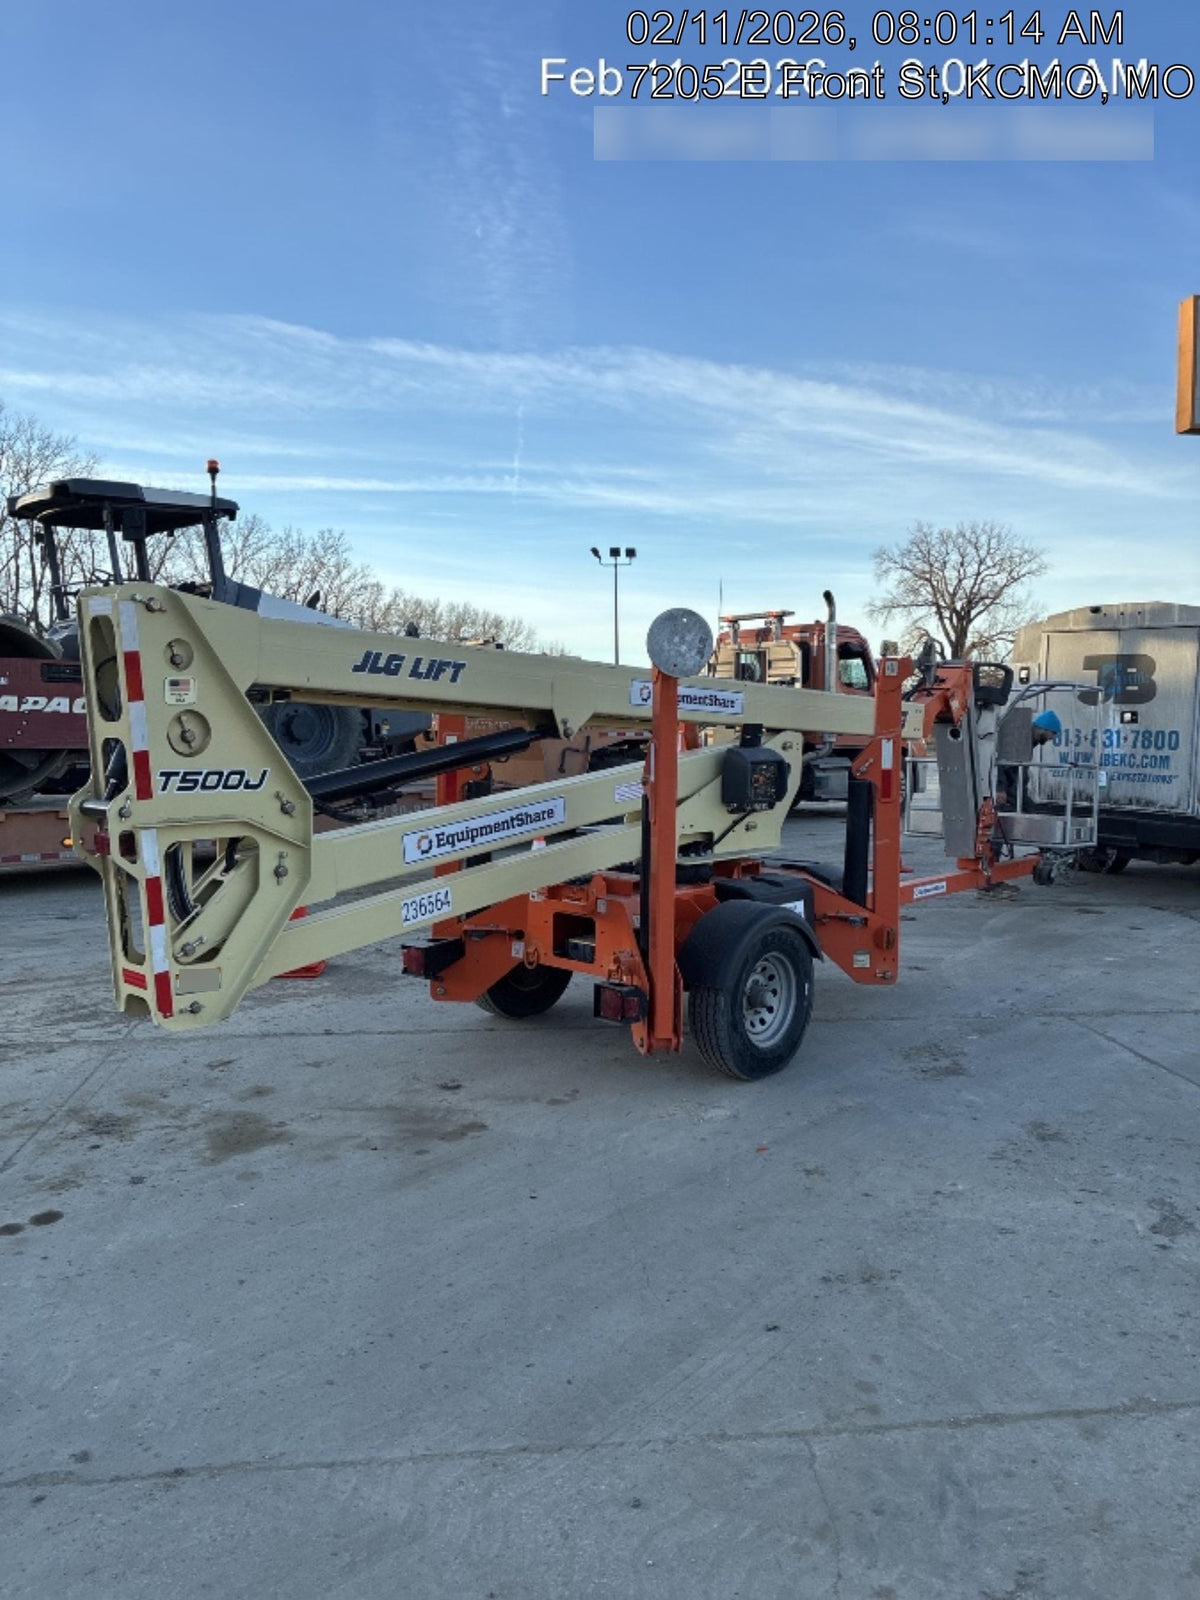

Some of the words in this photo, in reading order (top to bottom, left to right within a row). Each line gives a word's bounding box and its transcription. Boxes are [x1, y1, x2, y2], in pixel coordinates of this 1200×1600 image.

[352, 650, 405, 676] JLG
[408, 657, 466, 683] LIFT
[158, 769, 269, 793] T500J
[435, 807, 555, 848] EquipmentShare
[402, 889, 451, 923] 236564
